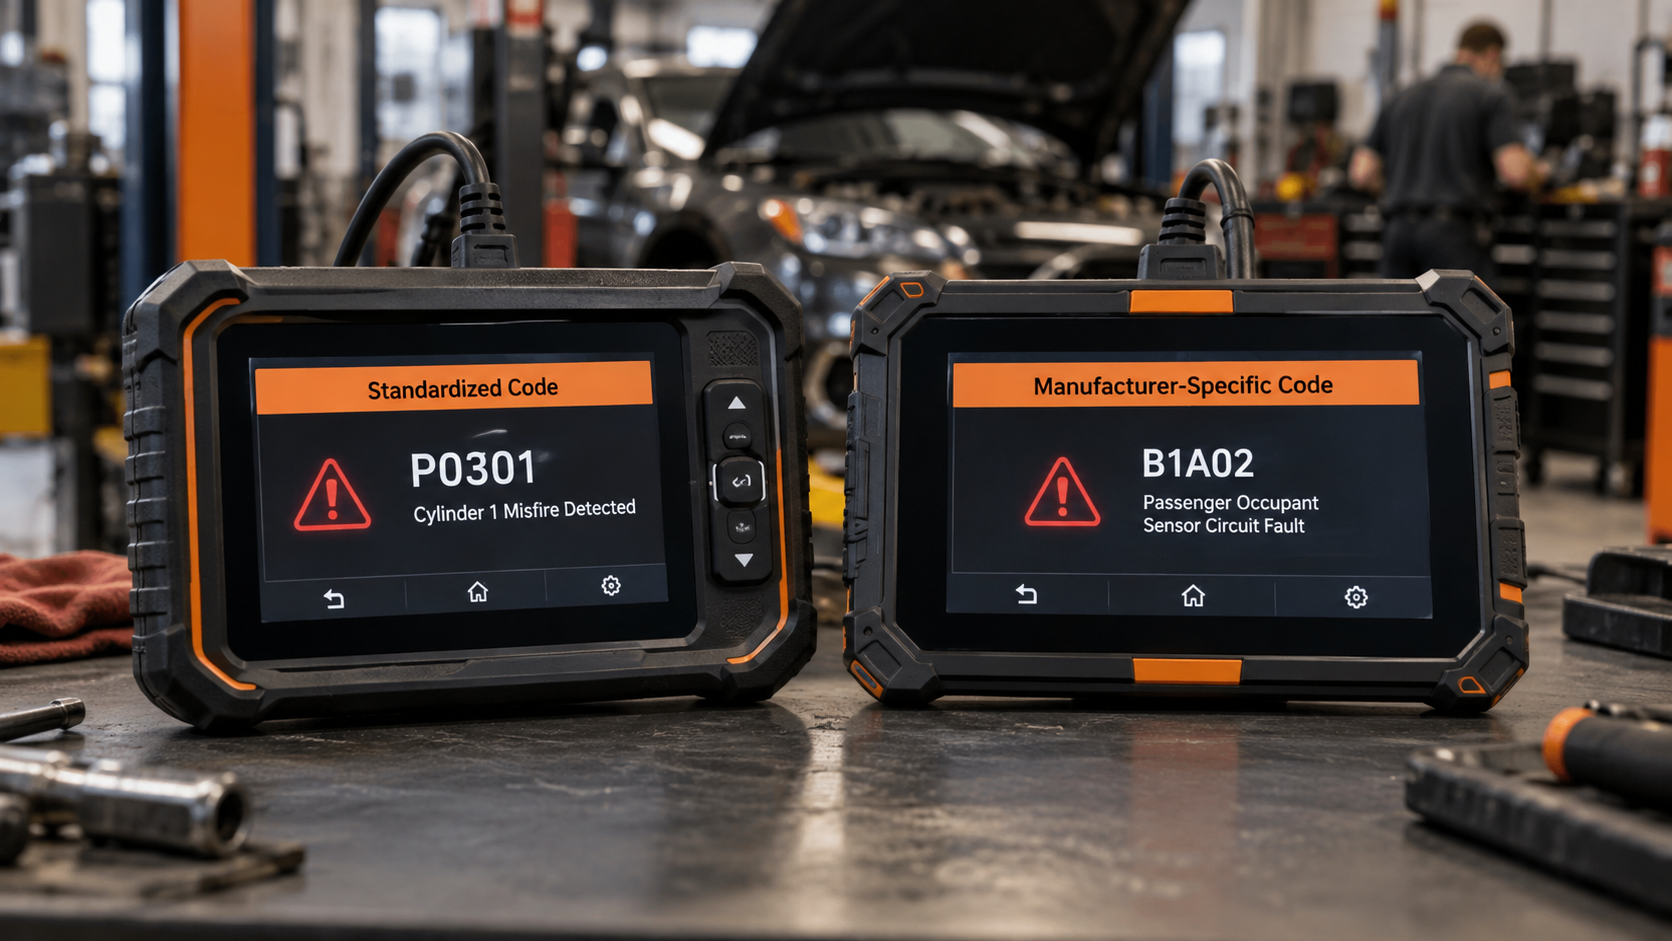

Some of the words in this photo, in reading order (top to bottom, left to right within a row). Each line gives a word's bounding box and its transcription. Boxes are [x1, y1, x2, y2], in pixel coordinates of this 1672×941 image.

[368, 377, 502, 400] Standardized
[507, 376, 559, 397] Code
[1034, 374, 1272, 400] Manufacturer-Specific
[1278, 374, 1334, 394] Code
[411, 449, 534, 488] P0301
[1143, 447, 1255, 478] B1A02
[413, 504, 485, 527] Cylinder
[489, 503, 497, 520] 1
[503, 501, 560, 519] Misfire
[563, 497, 636, 517] Detected
[1143, 494, 1232, 514] Passenger
[1236, 494, 1320, 514] Occupant
[1143, 517, 1202, 533] Sensor
[1205, 517, 1260, 534] Circuit
[1264, 517, 1306, 534] Fault
